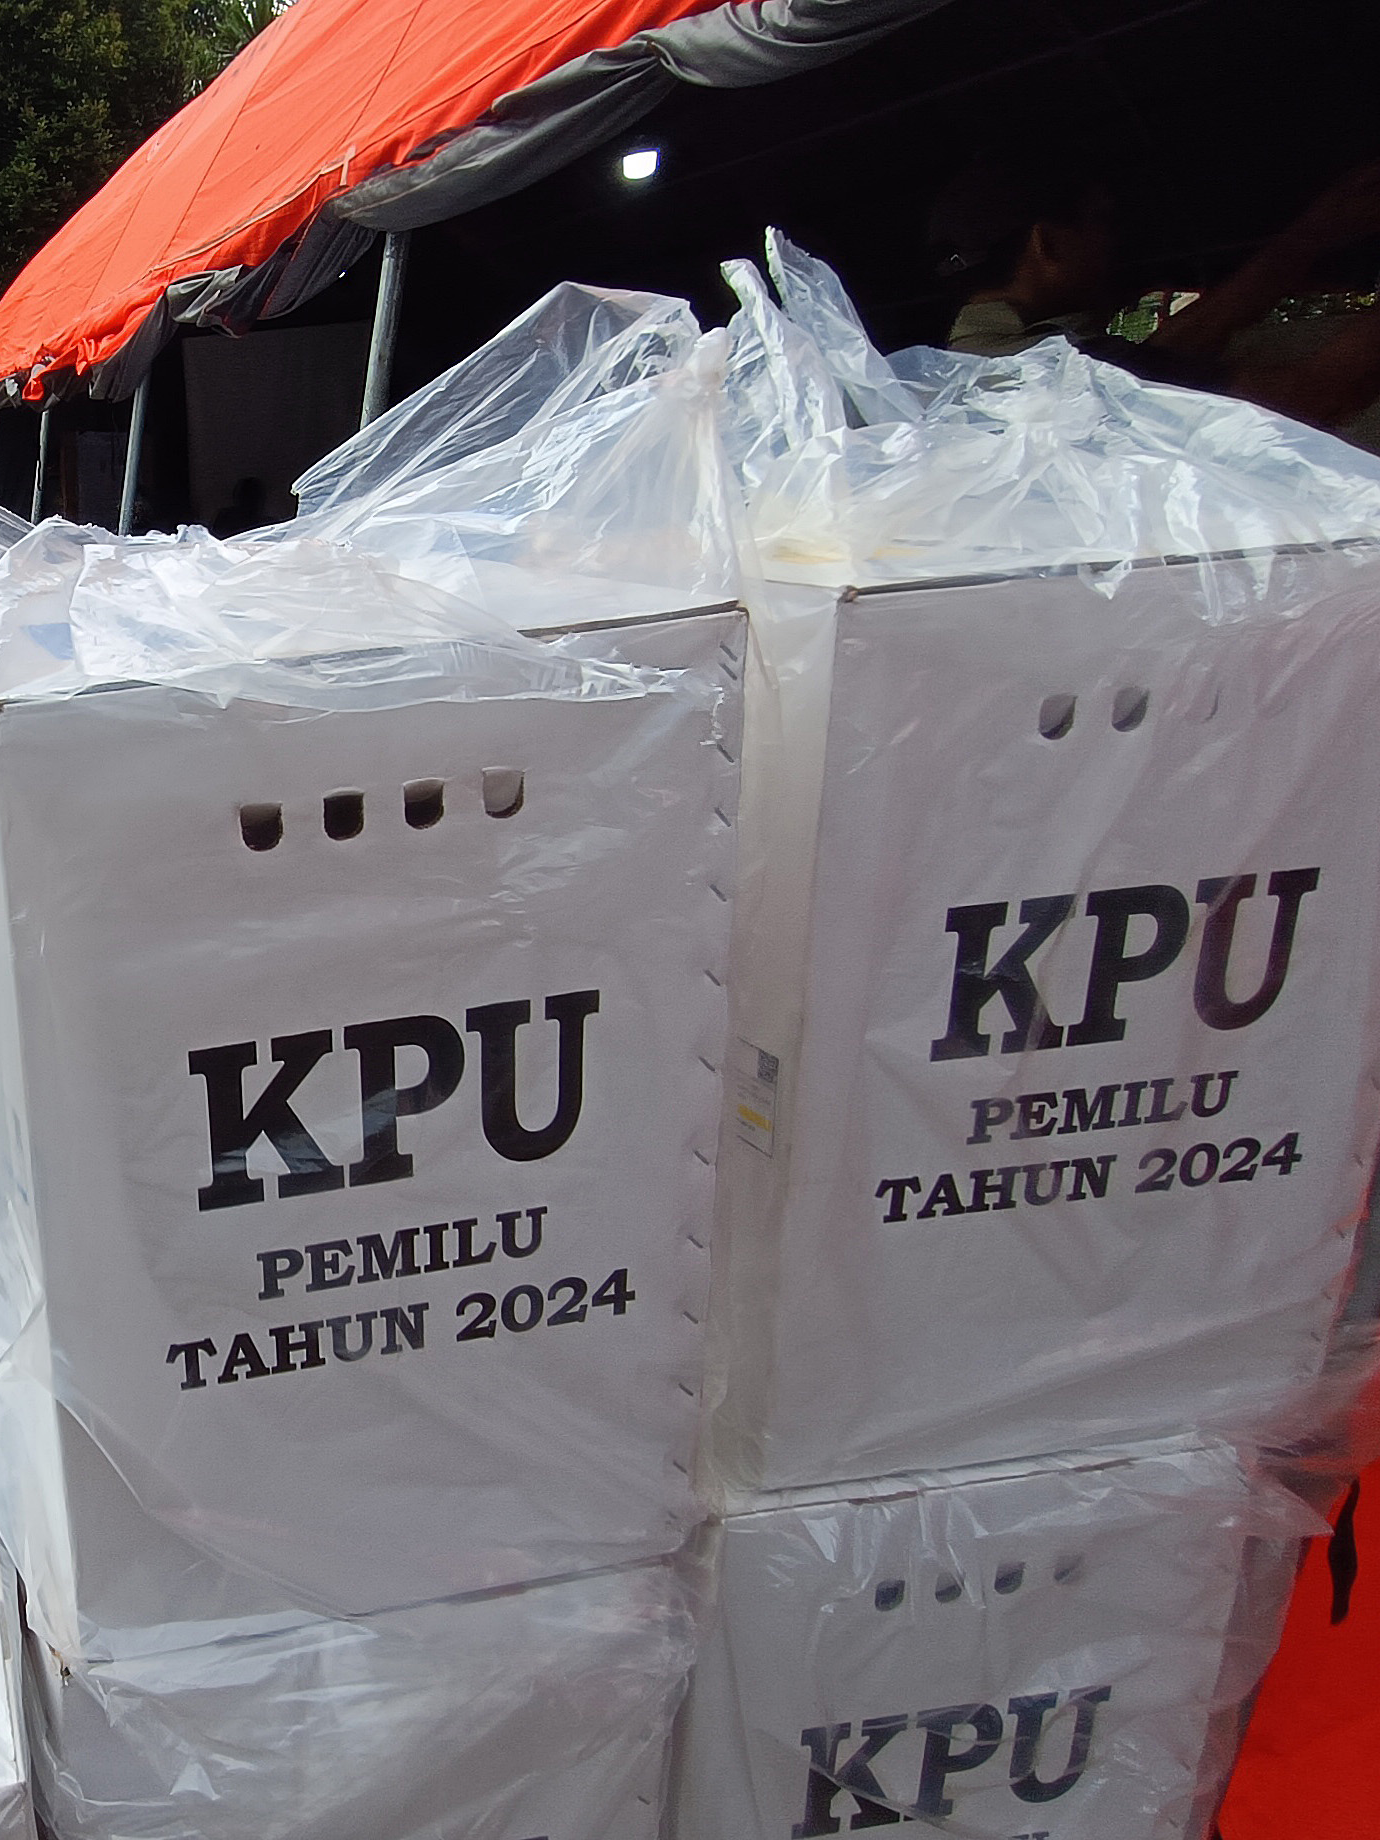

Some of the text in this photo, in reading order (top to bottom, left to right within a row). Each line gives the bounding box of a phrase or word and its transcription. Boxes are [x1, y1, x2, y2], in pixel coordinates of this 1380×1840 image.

[930, 867, 1320, 1061] KPU
[188, 989, 600, 1212] KPU
[965, 1070, 1240, 1145] PEMILU
[874, 1131, 1303, 1224] TAHUN 2024
[256, 1206, 548, 1300] PEMILU
[165, 1268, 636, 1391] TAHUN 2024
[791, 1685, 1112, 1839] KPU
